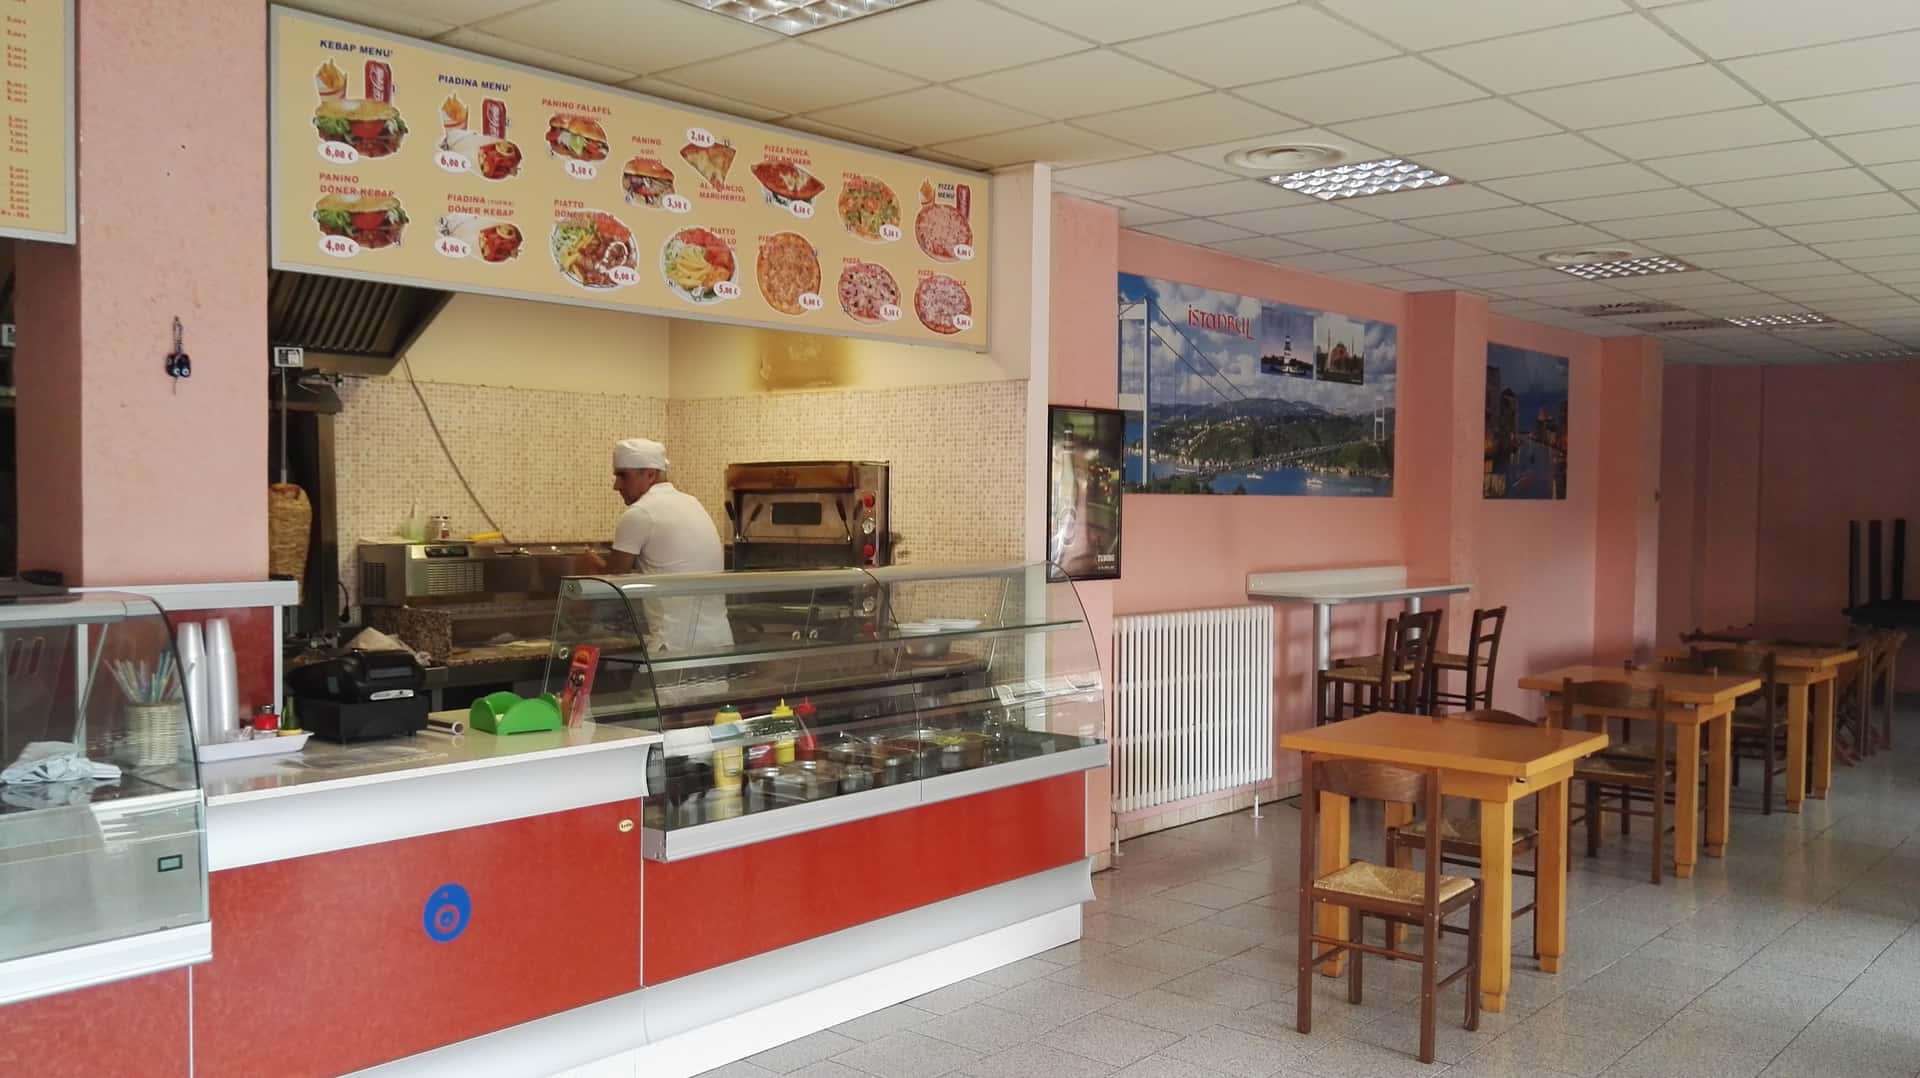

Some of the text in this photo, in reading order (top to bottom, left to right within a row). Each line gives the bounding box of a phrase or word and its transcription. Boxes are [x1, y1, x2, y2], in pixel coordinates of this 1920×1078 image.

[320, 40, 393, 57] KEBAP MENU'
[438, 74, 478, 87] PIADINA
[542, 98, 611, 115] PANINO FALAFEL
[631, 136, 662, 145] PANINO
[325, 145, 345, 158] 6,00
[764, 145, 784, 153] PIZZA
[440, 155, 459, 168] 6,00
[319, 172, 359, 183] PANINO
[447, 193, 486, 204] PIADINA
[554, 199, 584, 208] PIATTO
[326, 240, 345, 253] 4,00
[441, 240, 460, 253] 4,00
